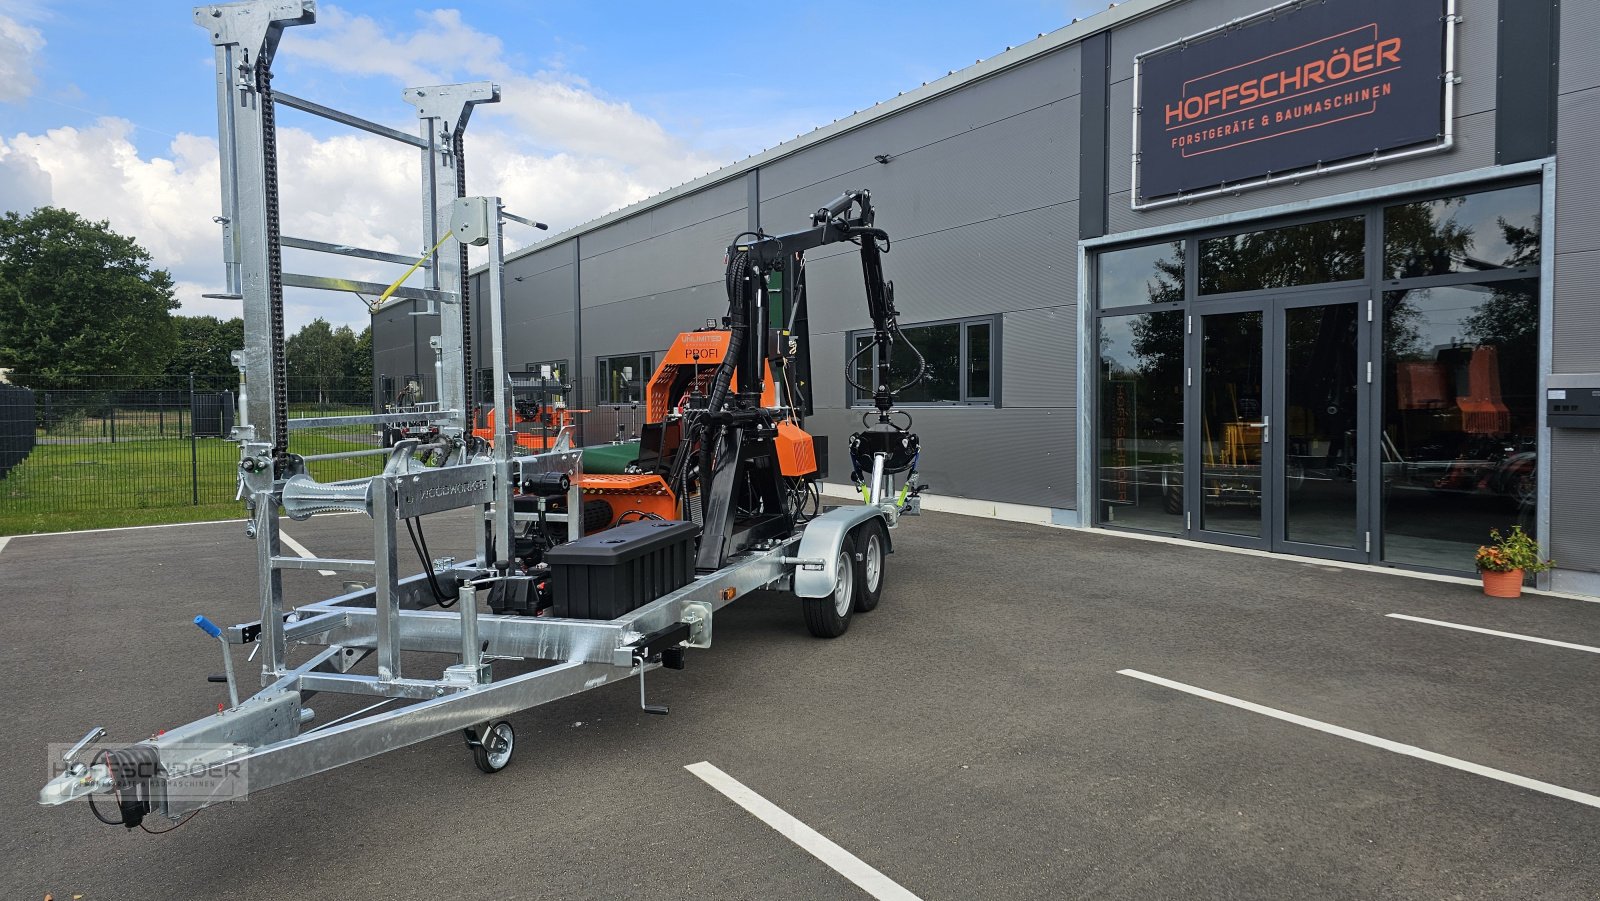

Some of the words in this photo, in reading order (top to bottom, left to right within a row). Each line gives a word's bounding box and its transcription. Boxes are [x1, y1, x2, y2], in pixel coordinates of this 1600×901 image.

[1165, 37, 1401, 125] HOFFSCHRÖER
[1172, 118, 1255, 149] FORSTGERÄTE
[1261, 114, 1269, 126] &
[1276, 82, 1391, 122] BAUMASCHINEN
[685, 348, 718, 358] PROFI
